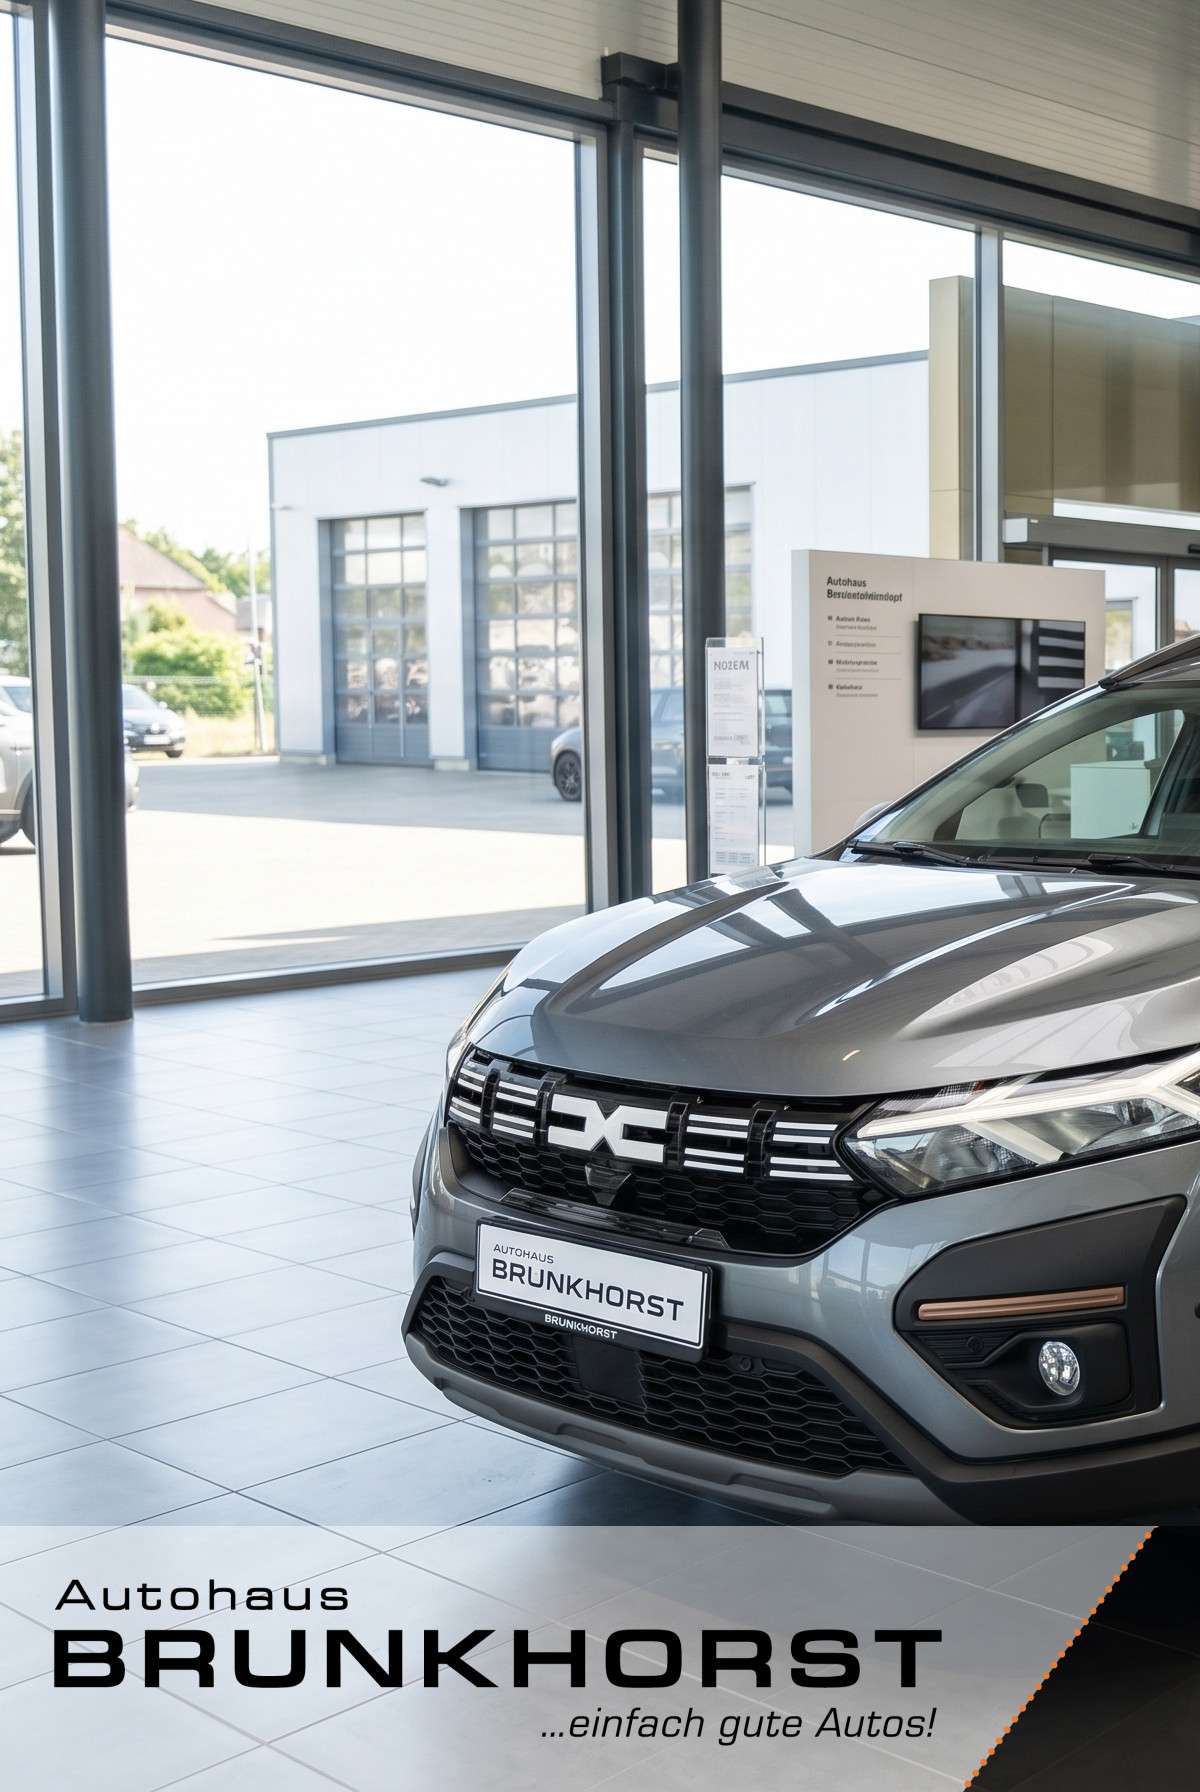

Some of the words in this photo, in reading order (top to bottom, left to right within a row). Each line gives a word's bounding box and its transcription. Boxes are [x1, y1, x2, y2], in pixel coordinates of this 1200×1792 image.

[826, 576, 867, 588] Autohaus
[493, 1243, 554, 1264] AUTOHAUS
[492, 1257, 685, 1321] BRUNKHORST
[544, 1313, 618, 1340] BRUNKHORST
